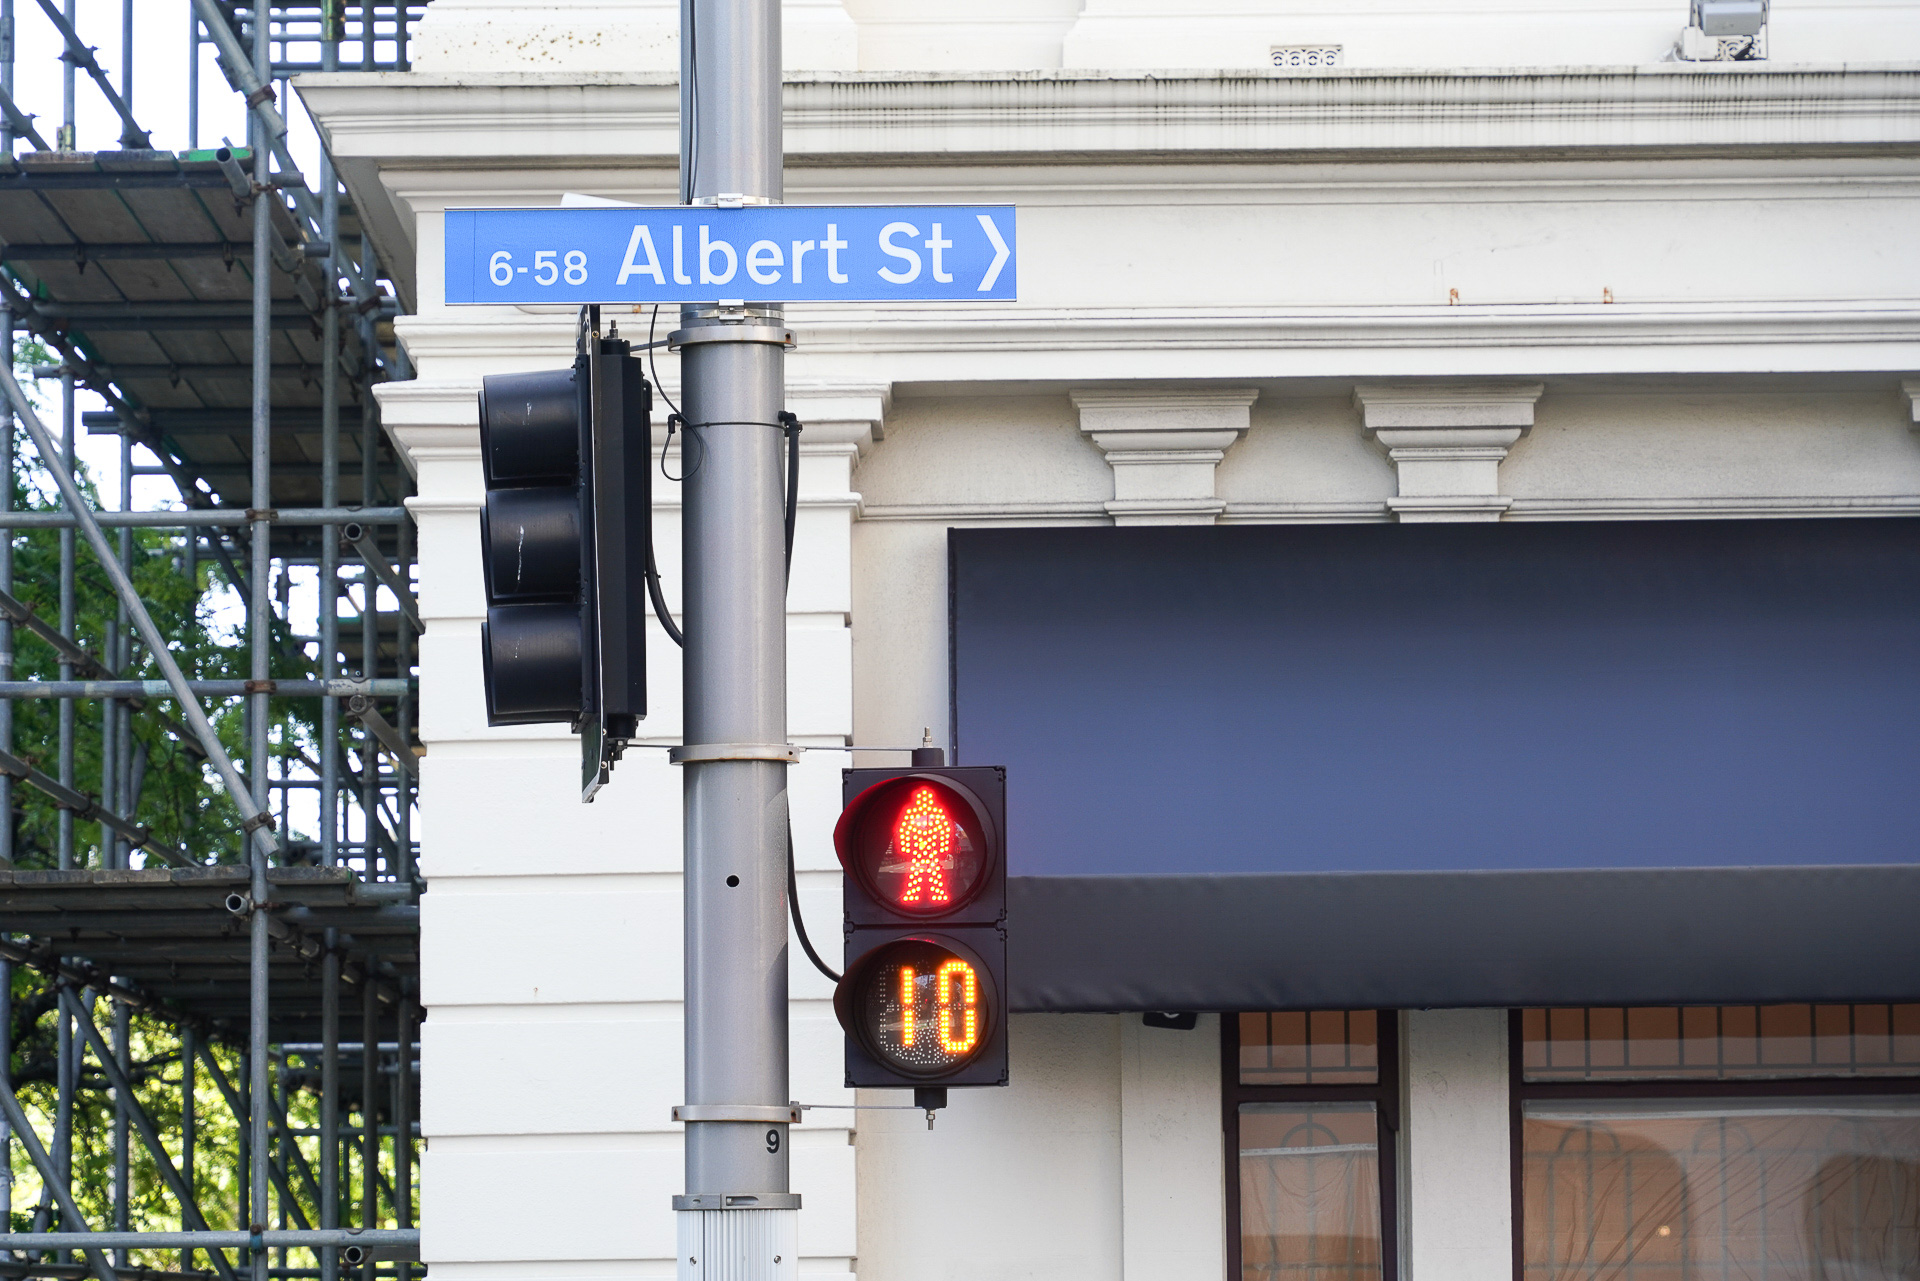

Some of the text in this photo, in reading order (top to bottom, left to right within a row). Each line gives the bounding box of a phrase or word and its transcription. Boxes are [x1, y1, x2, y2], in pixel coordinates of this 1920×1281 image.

[489, 221, 954, 287] 6-58 Albert St
[901, 960, 977, 1053] 10
[765, 1129, 780, 1154] 9
